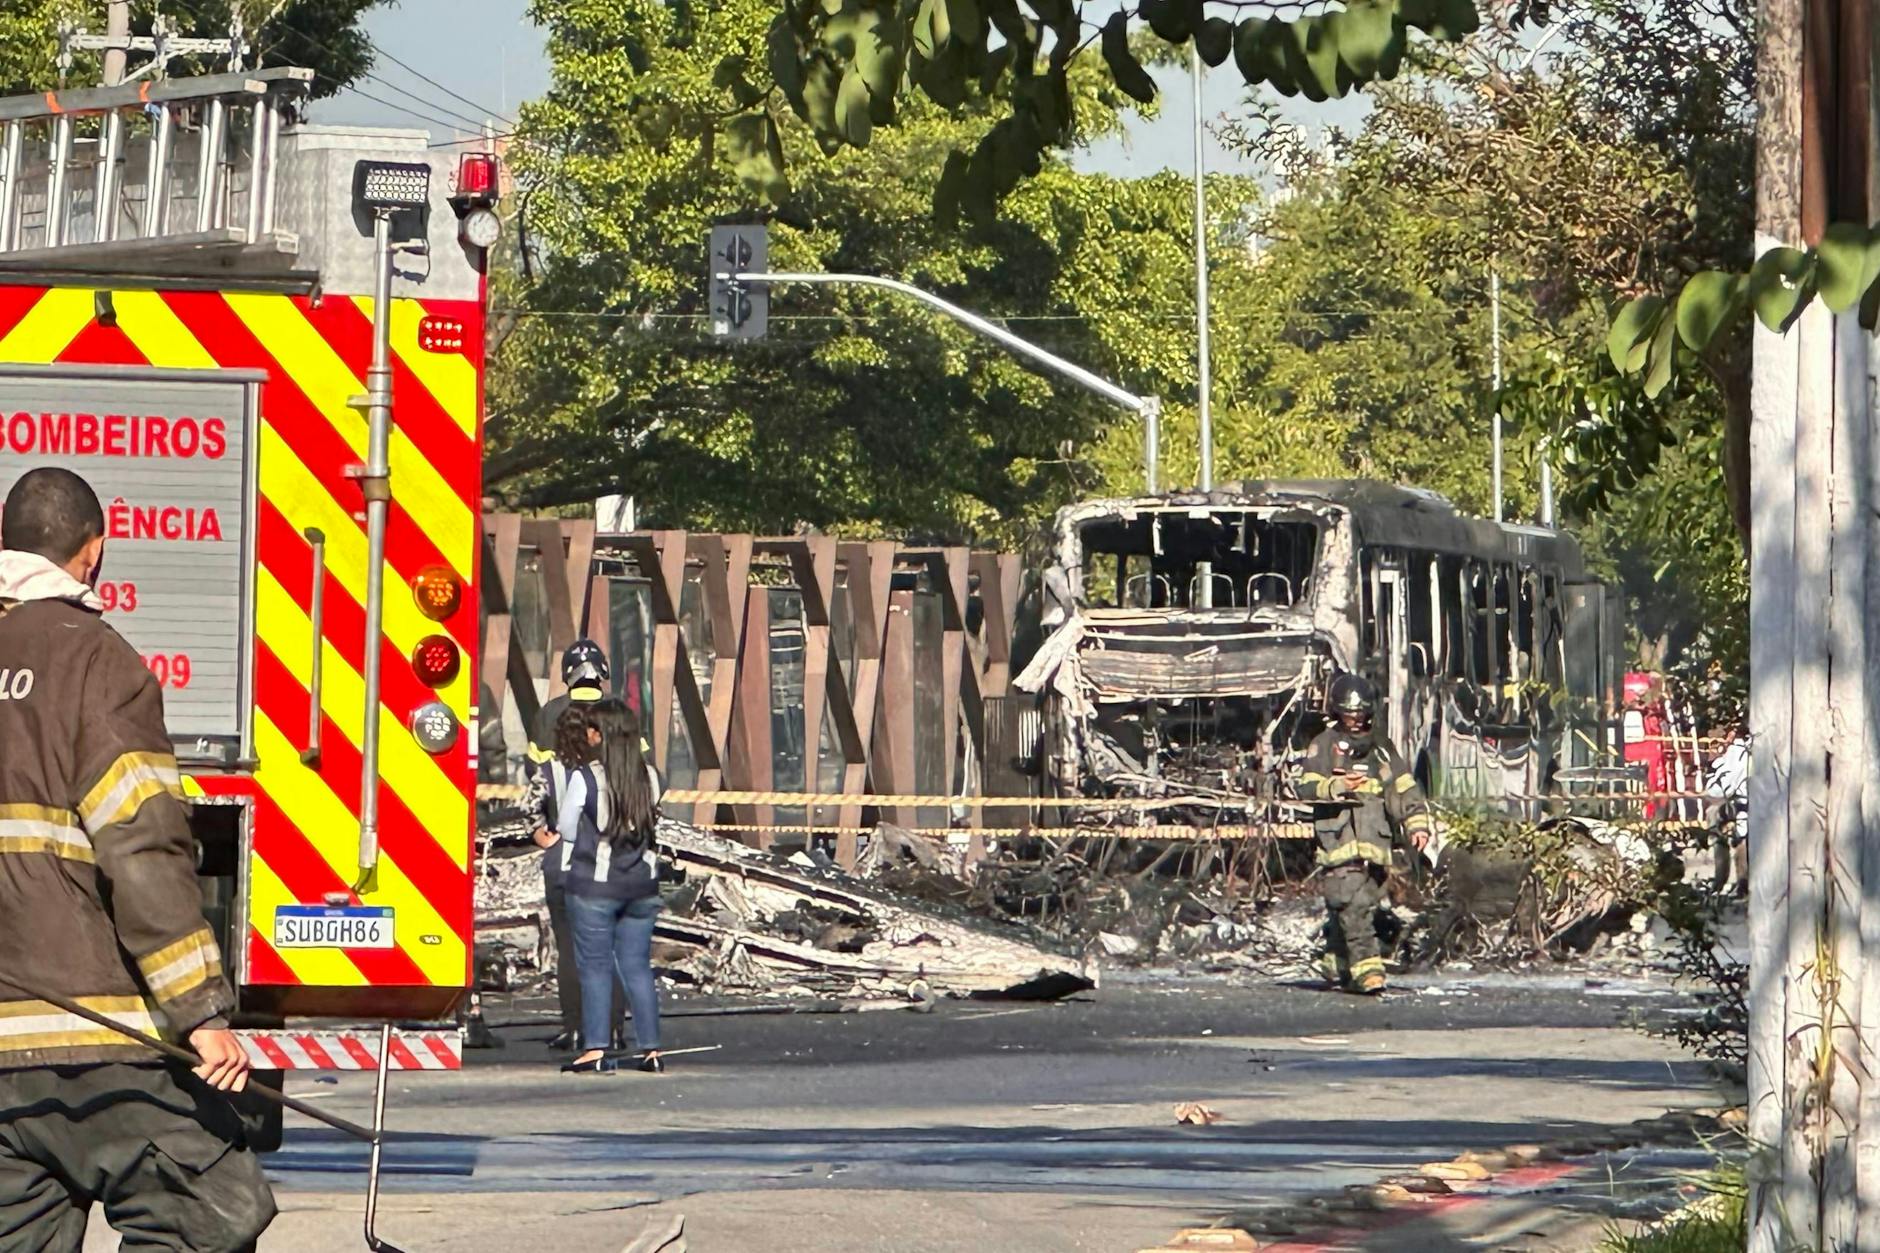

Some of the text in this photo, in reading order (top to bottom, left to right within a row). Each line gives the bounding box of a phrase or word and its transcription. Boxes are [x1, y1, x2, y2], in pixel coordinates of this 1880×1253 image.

[108, 497, 223, 541] ÊNCIA
[100, 582, 137, 612] 93
[0, 668, 34, 700] LO
[140, 654, 191, 688] 09
